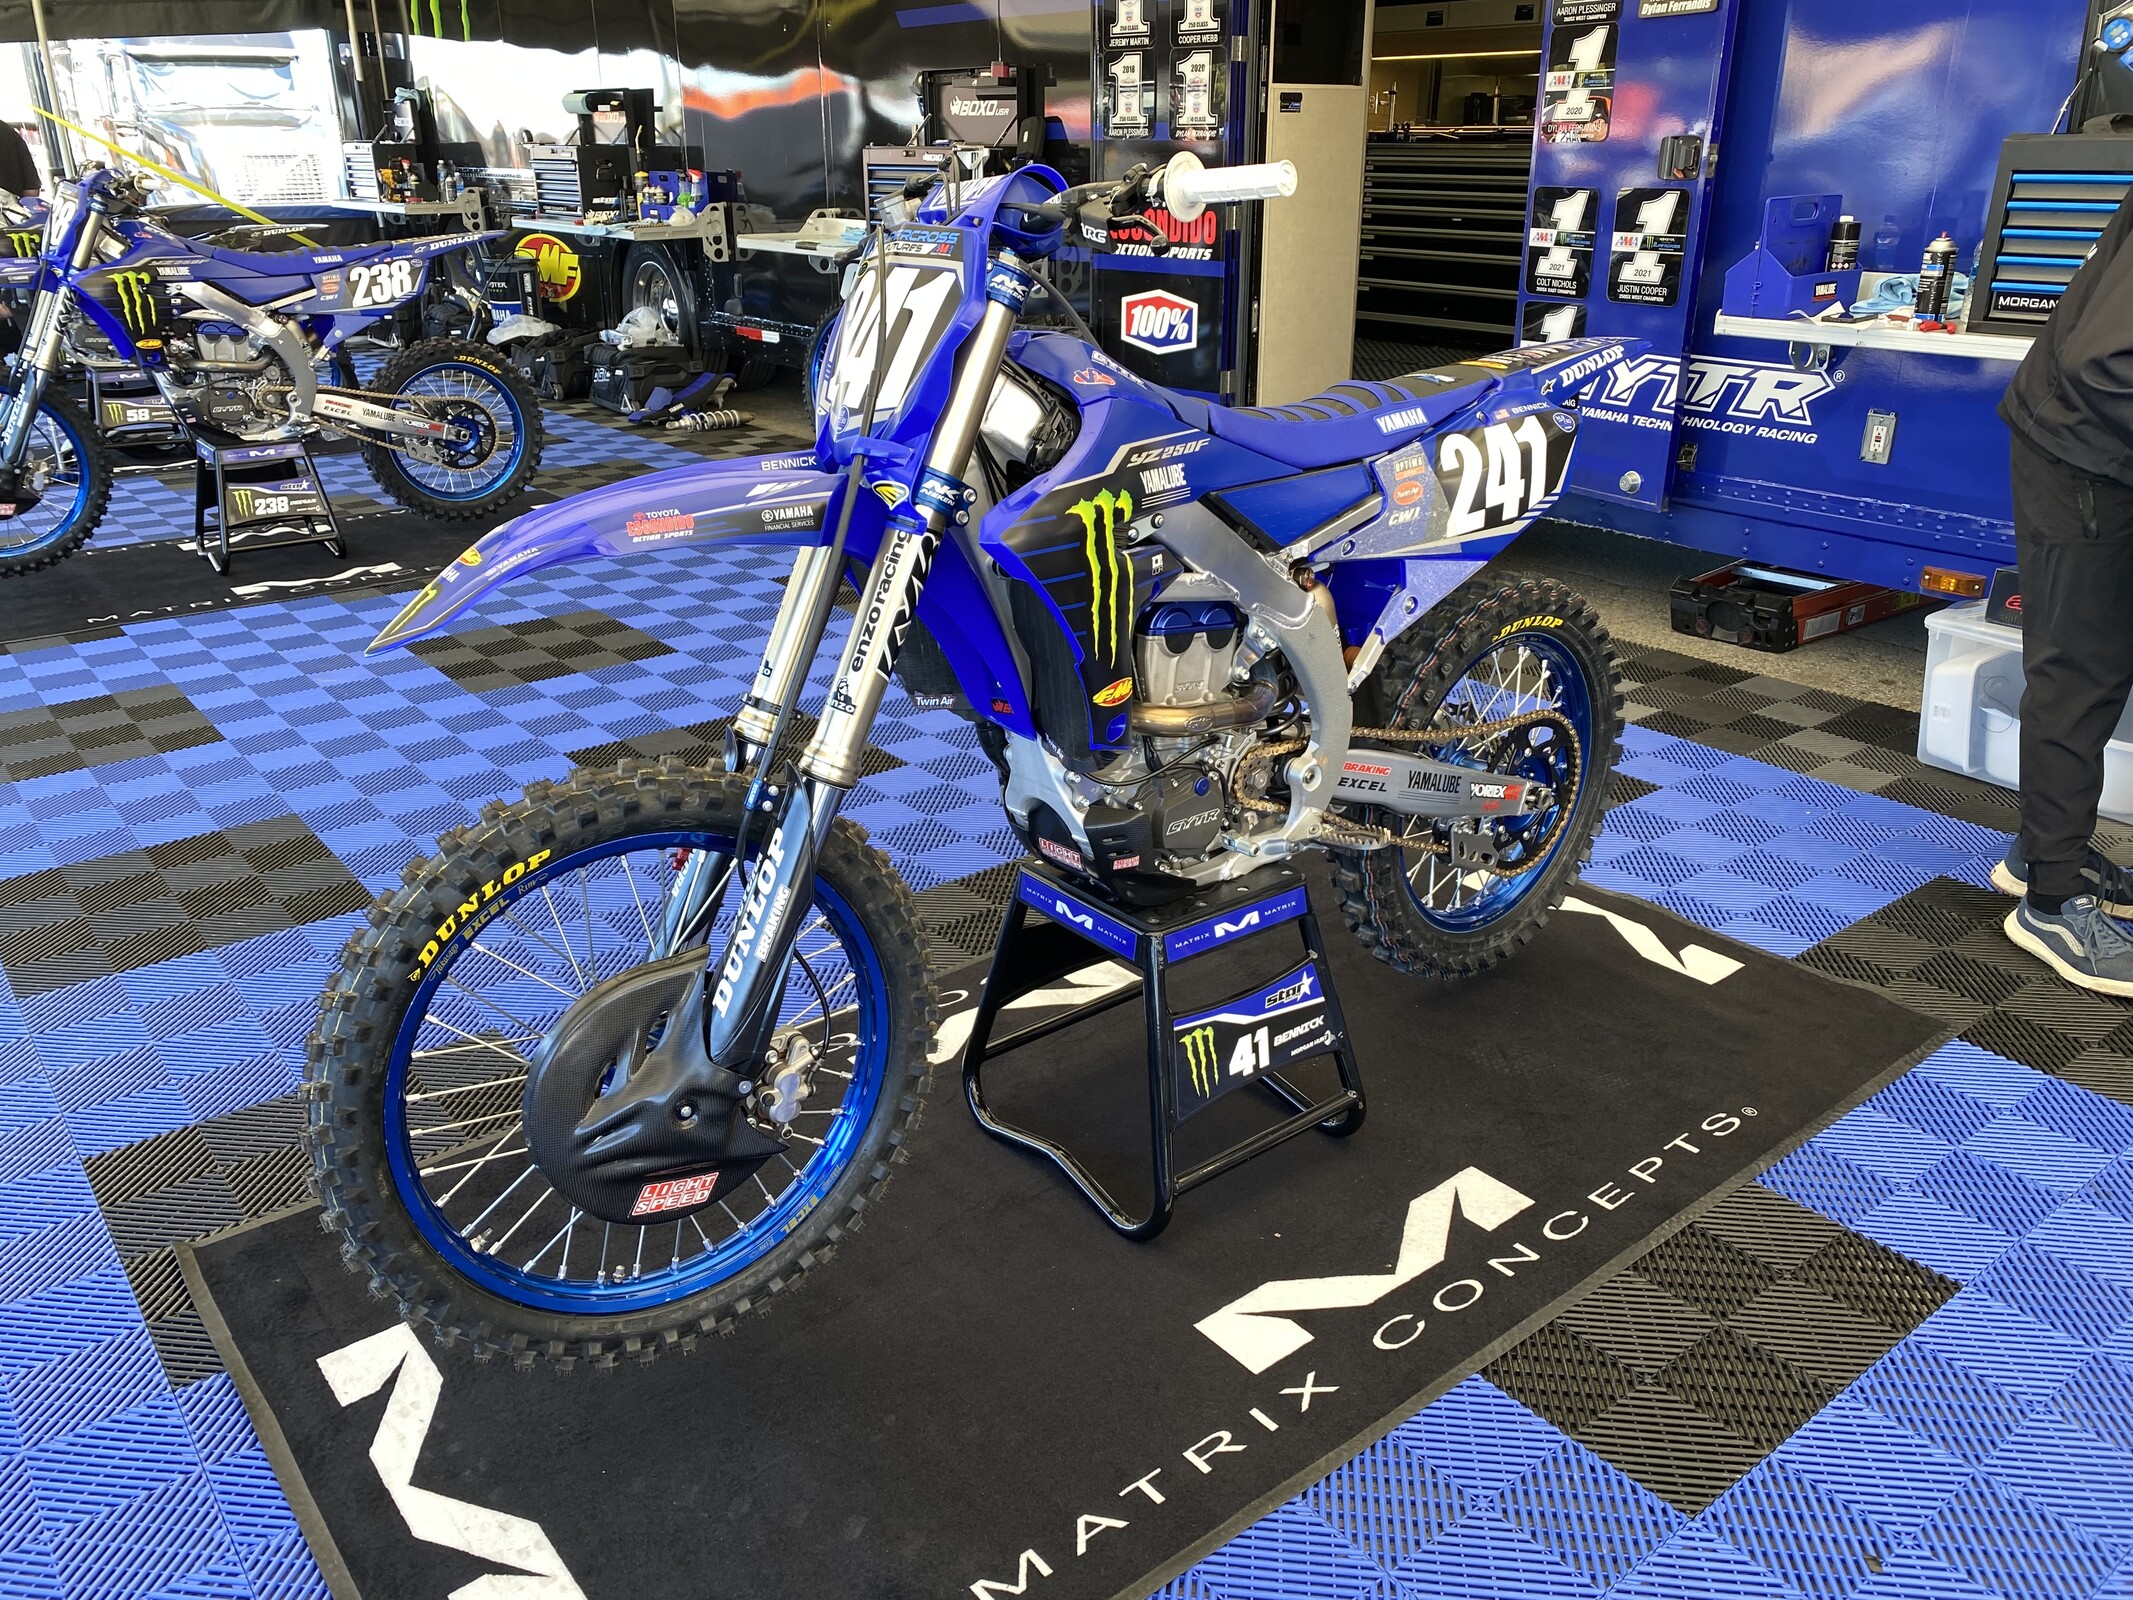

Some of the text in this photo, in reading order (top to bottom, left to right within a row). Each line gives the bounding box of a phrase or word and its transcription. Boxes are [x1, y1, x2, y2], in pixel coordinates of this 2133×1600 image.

[1556, 3, 1616, 17] AARON PLESSINGER
[1641, 0, 1711, 15] Dylan Ferrandis
[1109, 36, 1149, 47] JEREMY MARTIN
[1178, 33, 1218, 45] COOPER WEBB
[1565, 106, 1583, 115] 2020
[262, 226, 307, 237] DUNLOP
[429, 233, 482, 251] DUNLOP
[312, 254, 344, 265] YAMAHA
[1548, 263, 1565, 272] 2021
[156, 266, 191, 276] YAMALUBE
[1633, 268, 1652, 278] 2021
[349, 259, 413, 308] 238
[989, 282, 1025, 303] NEKEN
[1536, 278, 1577, 290] COLT NICHOLS
[1617, 285, 1668, 297] JUSTIN COOPER
[1129, 304, 1190, 341] 100%
[457, 354, 502, 375] DUNLOP
[1559, 344, 1625, 387] DUNLOP
[126, 408, 150, 422] 58
[323, 405, 352, 417] EXCEL
[361, 407, 396, 422] YAMALUBE
[1511, 401, 1550, 415] BENNICK
[1375, 406, 1428, 434] YAMAHA
[1580, 405, 1630, 424] YAMAHA
[1754, 425, 1819, 445] RACING
[1126, 437, 1211, 468] YZ250F
[761, 455, 818, 471] BENNICK
[1395, 455, 1423, 473] OPTIMA
[1139, 462, 1187, 495] YAMALUBE
[1439, 414, 1548, 539] 241
[254, 496, 290, 516] 238
[920, 488, 956, 507] NEKEN
[645, 508, 681, 519] TOYOTA
[772, 504, 814, 521] YAMAHA
[626, 513, 695, 537] ESCONDIDO
[764, 519, 815, 532] FINANCIAL SERVICES
[632, 529, 694, 543] ACTION SPORTS
[851, 603, 882, 673] enzo
[874, 530, 914, 605] racing
[1498, 614, 1565, 641] DUNLOP
[916, 695, 955, 707] Twin Air
[1342, 761, 1392, 777] BRAKING
[1337, 776, 1388, 793] EXCEL
[1407, 769, 1462, 794] YAMALUBE
[1469, 782, 1507, 800] VORTEX
[1165, 807, 1221, 837] GYTR
[417, 848, 551, 969] DUNLOP
[1026, 886, 1054, 907] MATRIX
[1097, 926, 1128, 946] MATRIX
[460, 897, 510, 941] EXCEL
[712, 826, 786, 1019] DUNLOP
[756, 884, 790, 960] BRAKING
[1175, 931, 1211, 949] MATRIX
[1263, 899, 1297, 917] MATRIX
[1273, 1014, 1325, 1047] BENNICK
[1228, 1025, 1271, 1078] 41
[1290, 1040, 1315, 1057] MORGAN
[639, 1172, 719, 1201] LIGHT
[632, 1188, 714, 1216] SPEED
[969, 1370, 1340, 1600] MATRIX
